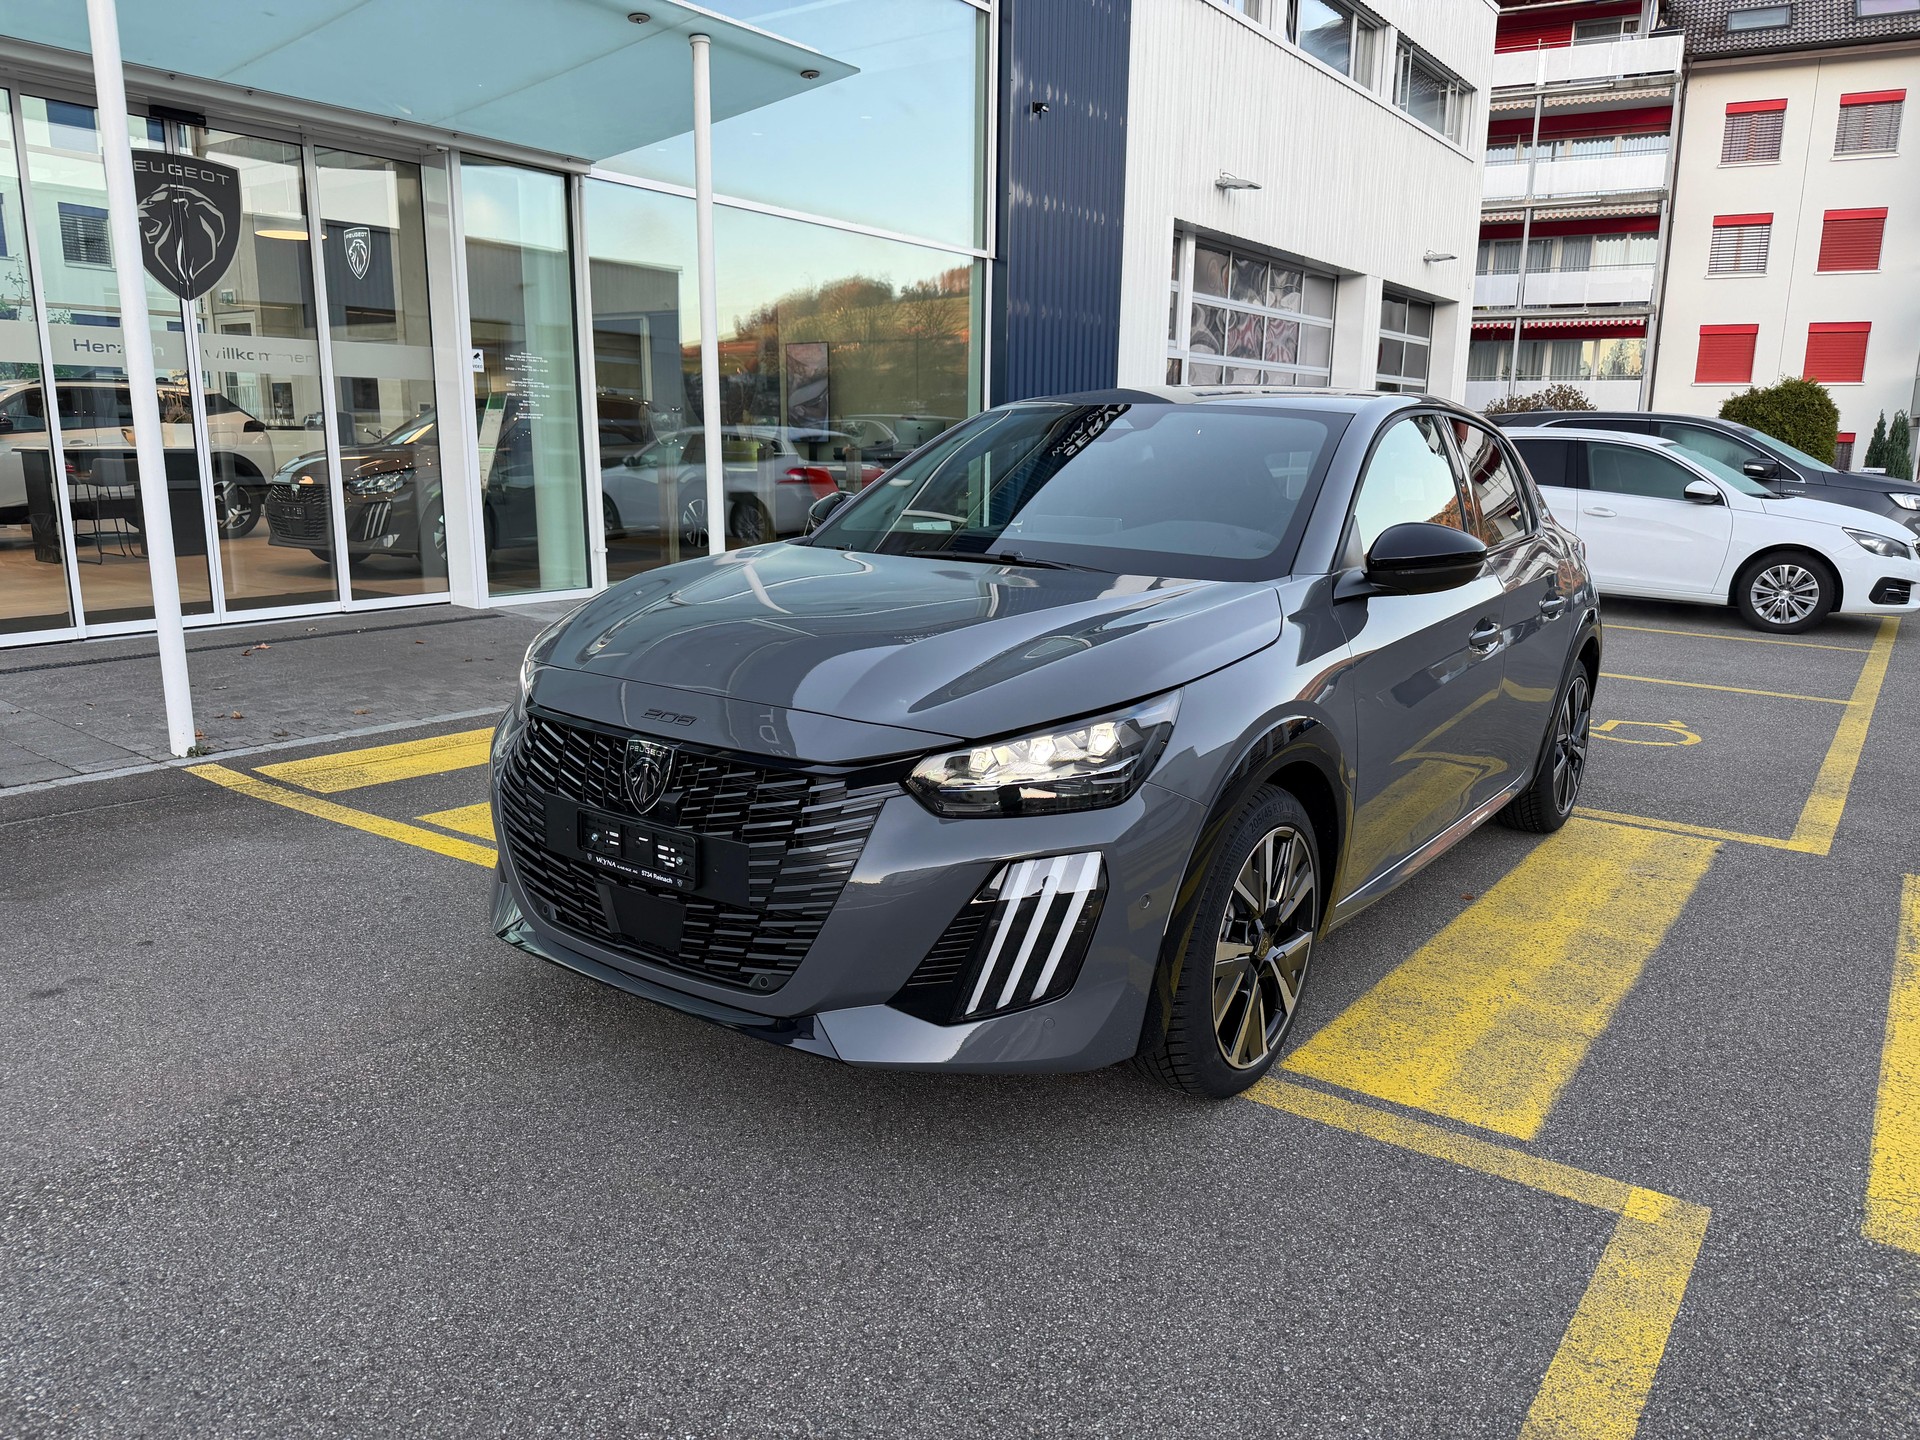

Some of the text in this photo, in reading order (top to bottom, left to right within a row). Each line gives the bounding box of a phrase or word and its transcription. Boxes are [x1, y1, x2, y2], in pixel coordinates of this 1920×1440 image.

[132, 160, 230, 185] EUGEOT
[345, 231, 368, 239] PEUGEOT
[640, 708, 698, 727] 208
[629, 745, 668, 758] PEUGEOT
[652, 873, 673, 884] Reinach
